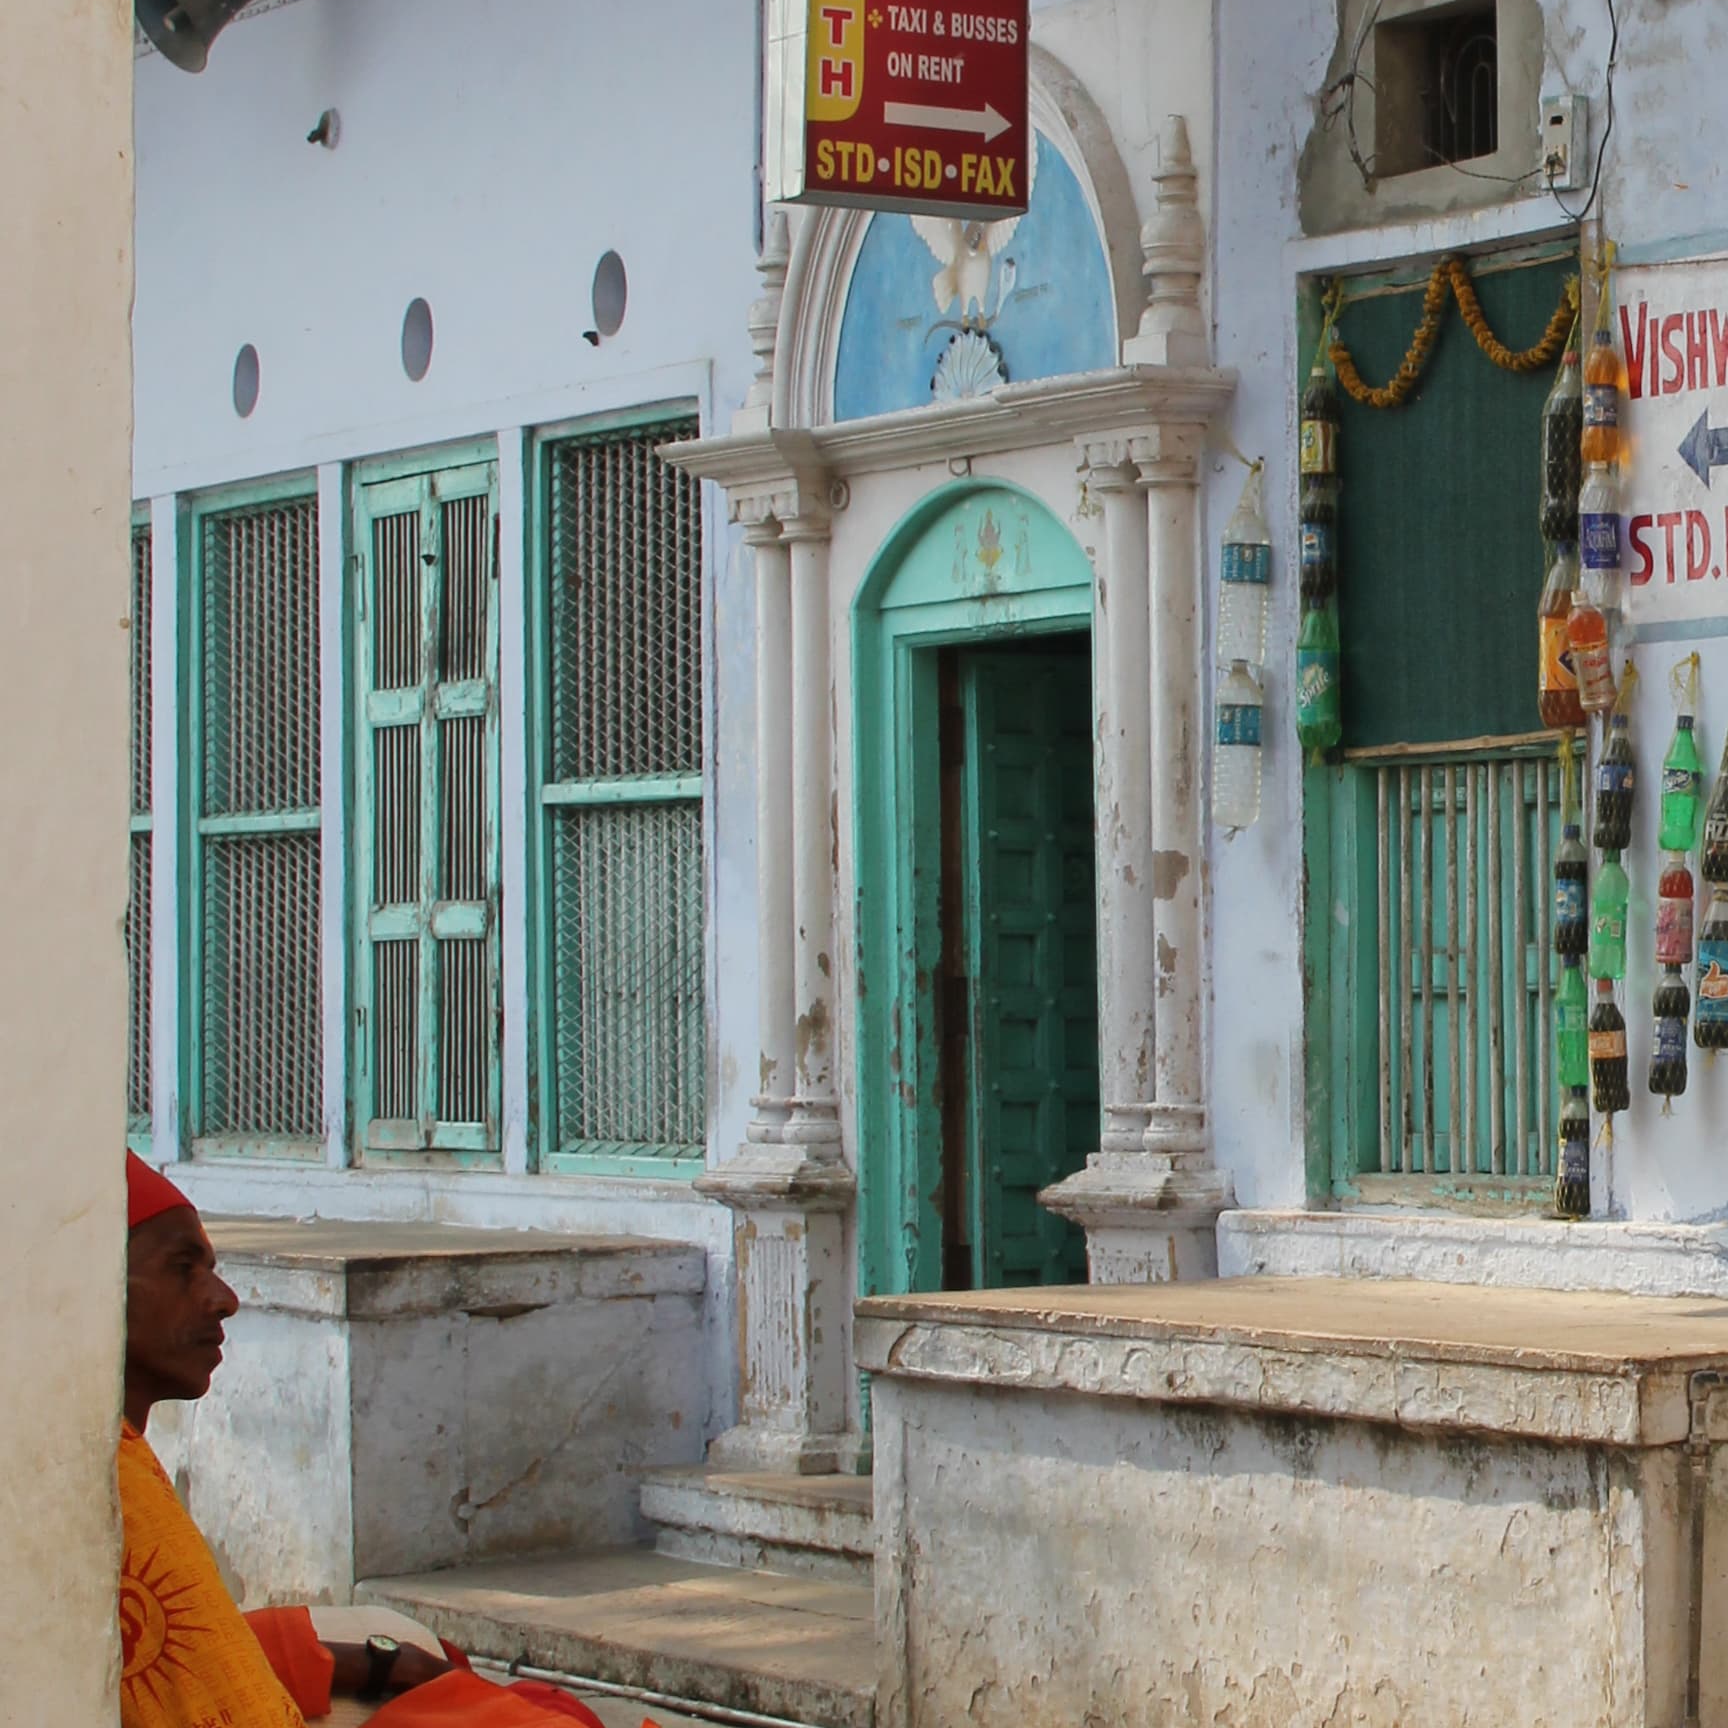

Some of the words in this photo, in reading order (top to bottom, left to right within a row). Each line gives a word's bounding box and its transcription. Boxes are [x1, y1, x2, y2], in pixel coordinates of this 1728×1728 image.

[888, 5, 928, 34] TAXI
[933, 11, 945, 36] &
[951, 16, 1018, 45] BUSSES
[887, 52, 912, 79] ON
[918, 55, 965, 83] RENT
